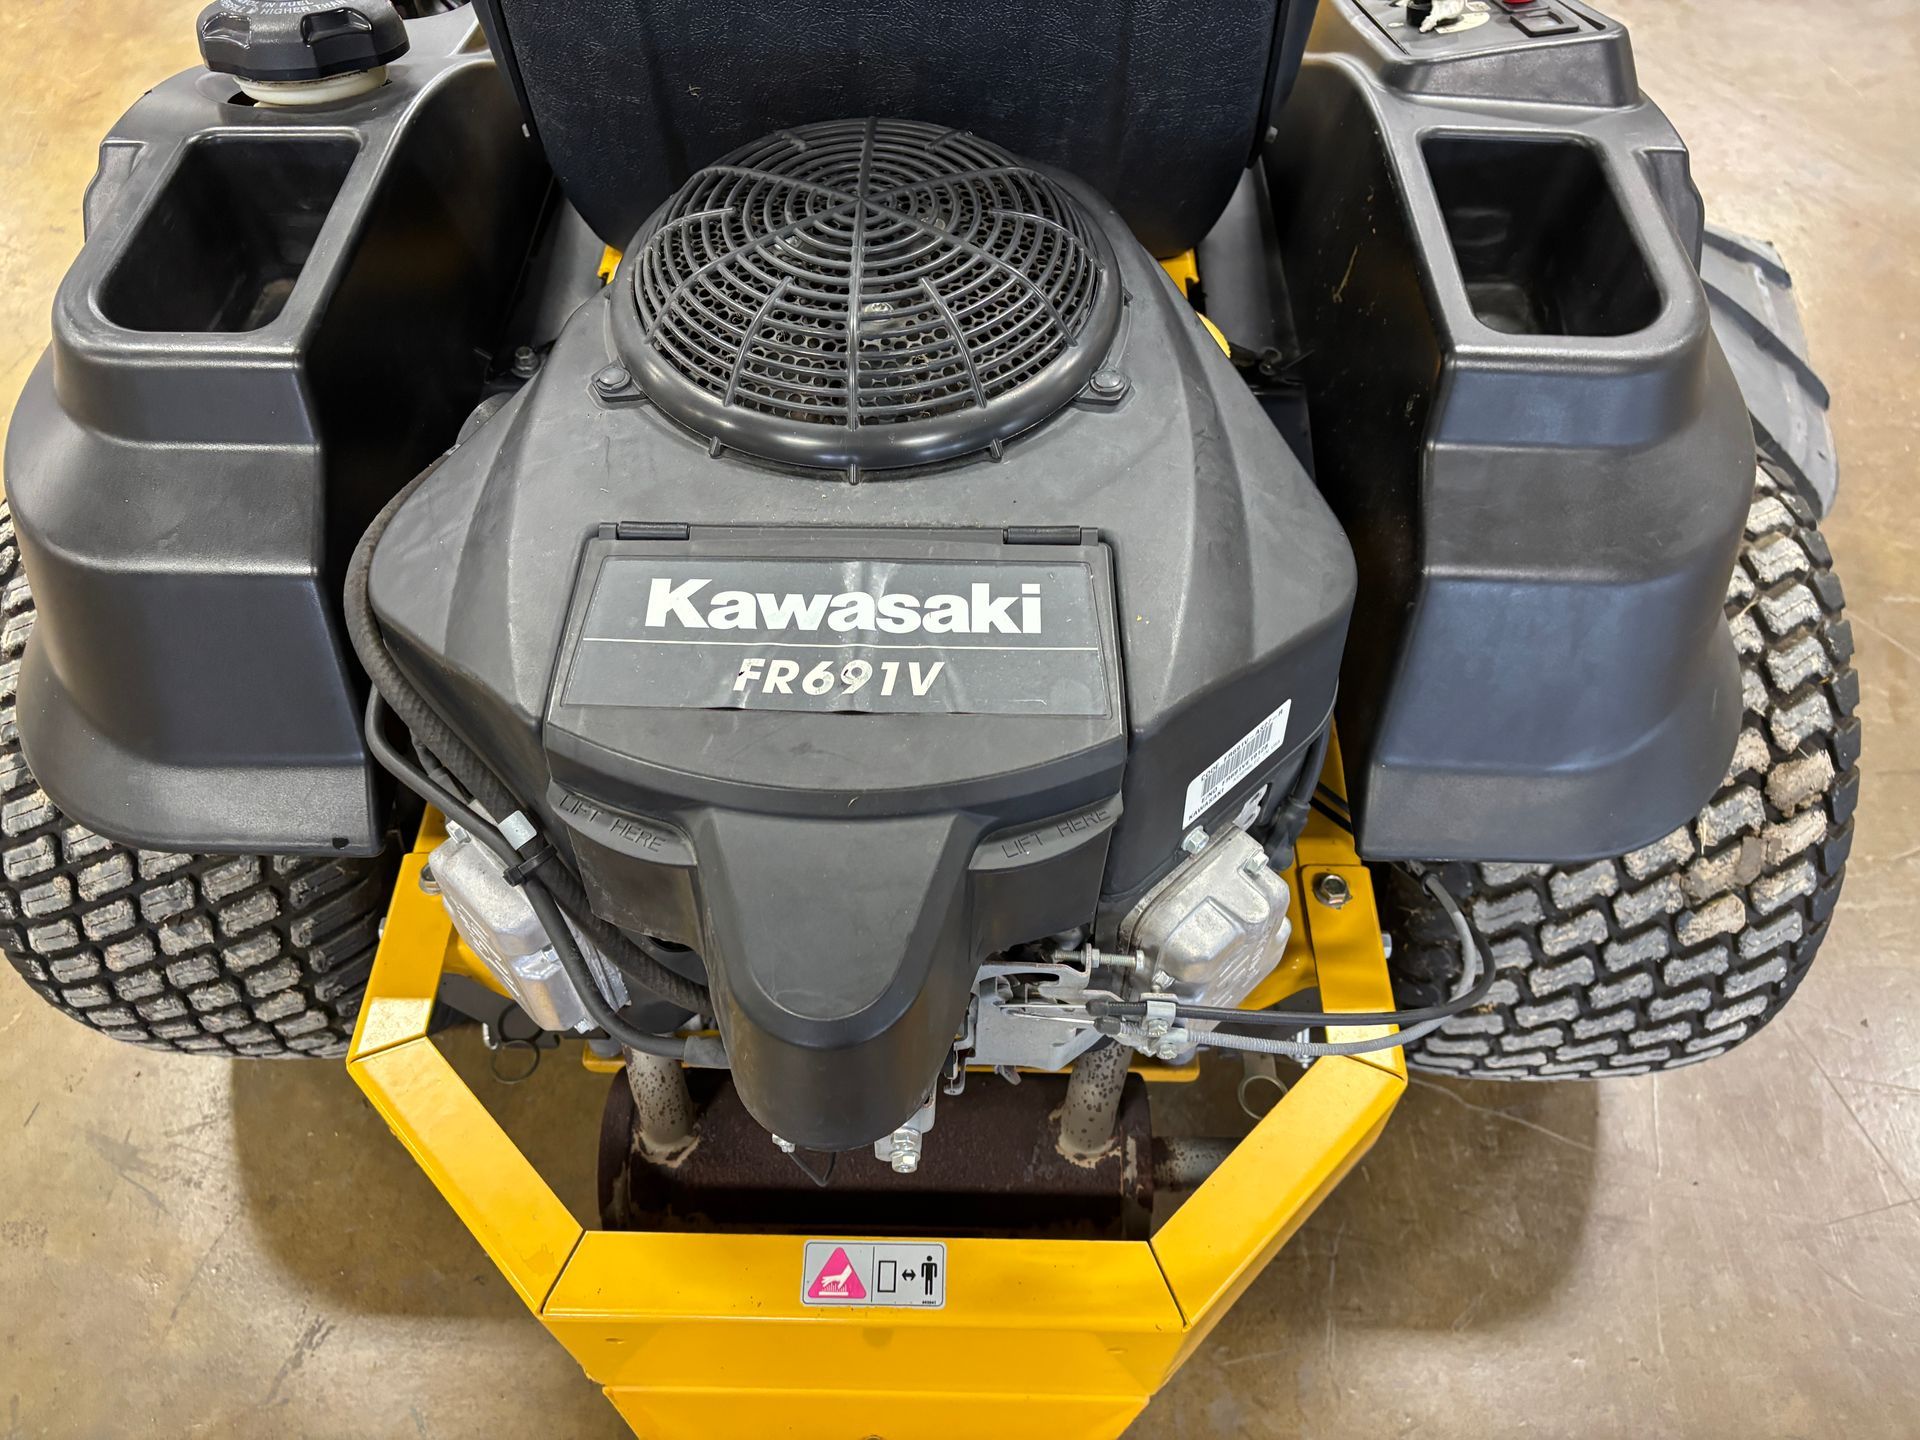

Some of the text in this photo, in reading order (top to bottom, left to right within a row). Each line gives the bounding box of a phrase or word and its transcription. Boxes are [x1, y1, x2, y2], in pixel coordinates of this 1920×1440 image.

[260, 5, 310, 15] HIGHER
[279, 0, 314, 8] FUEL
[645, 578, 1041, 634] Kawasaki
[733, 658, 944, 696] FR691V
[559, 795, 668, 852] LIFT HERE
[1188, 788, 1225, 821] KAWASAKI
[1001, 809, 1113, 859] LIFT HERE
